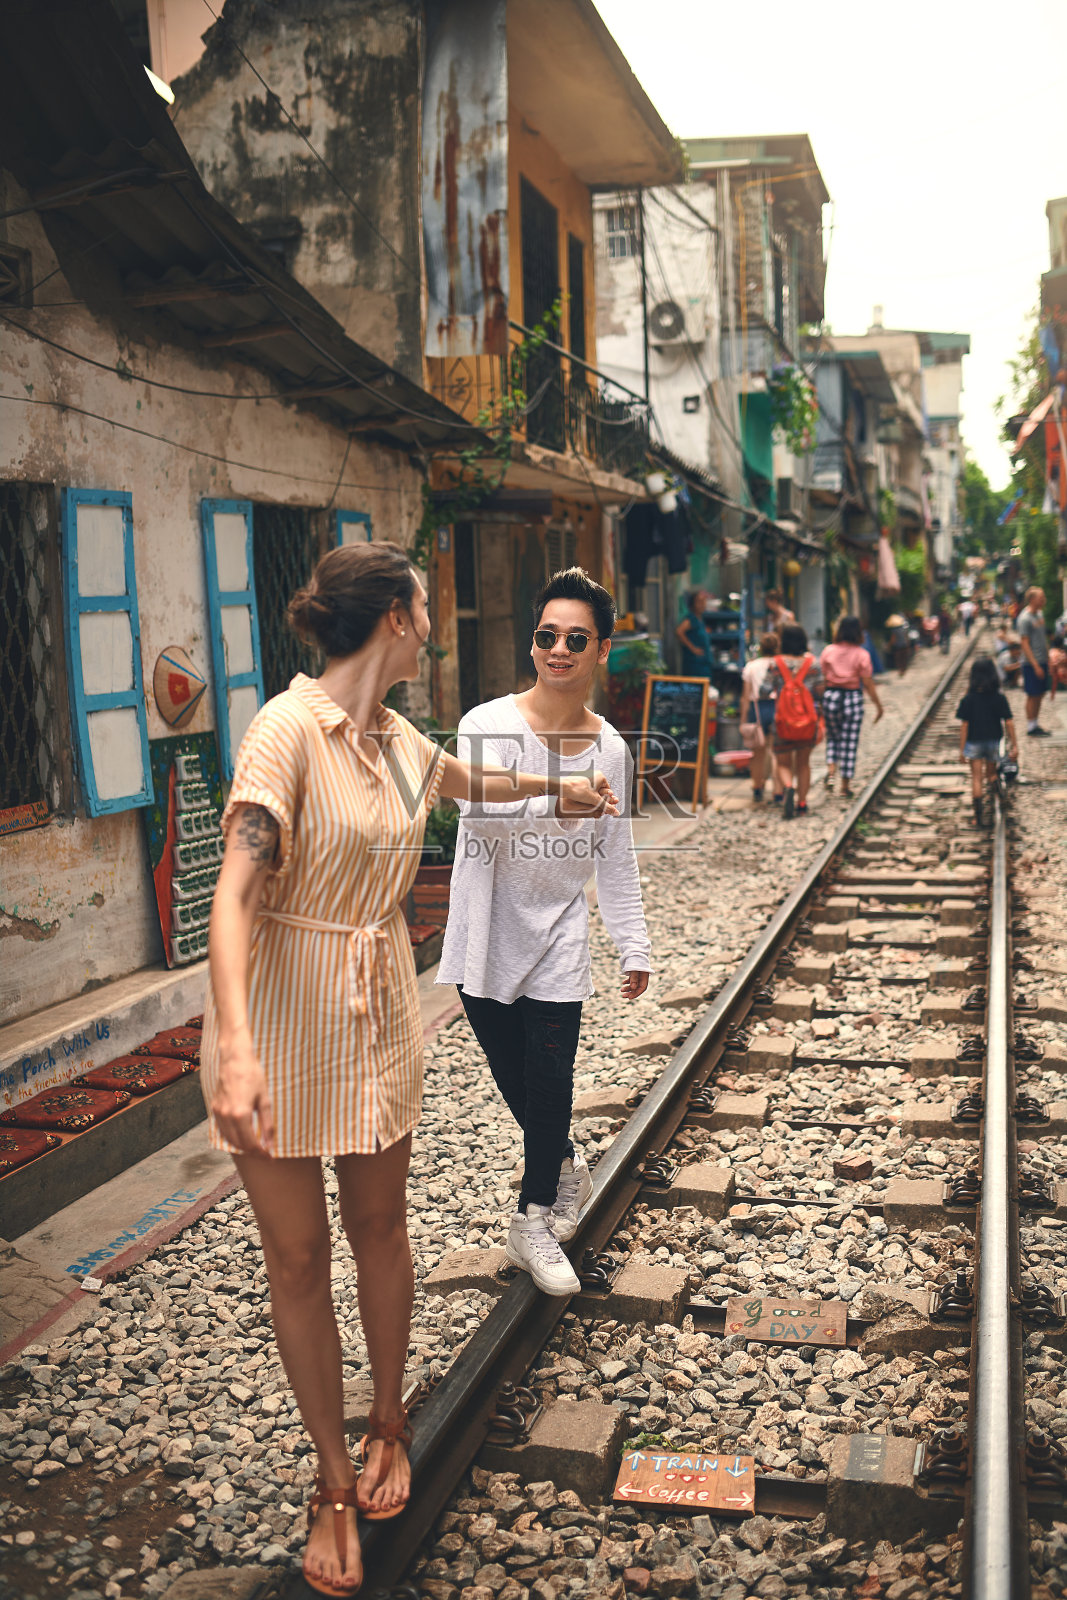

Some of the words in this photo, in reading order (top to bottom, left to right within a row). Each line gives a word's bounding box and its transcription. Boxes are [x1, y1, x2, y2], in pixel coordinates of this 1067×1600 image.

[22, 1048, 56, 1083] Porch
[96, 1023, 110, 1040] Us
[65, 1248, 115, 1275] SAFE
[769, 1322, 818, 1340] DAY
[647, 1484, 709, 1504] Coffee
